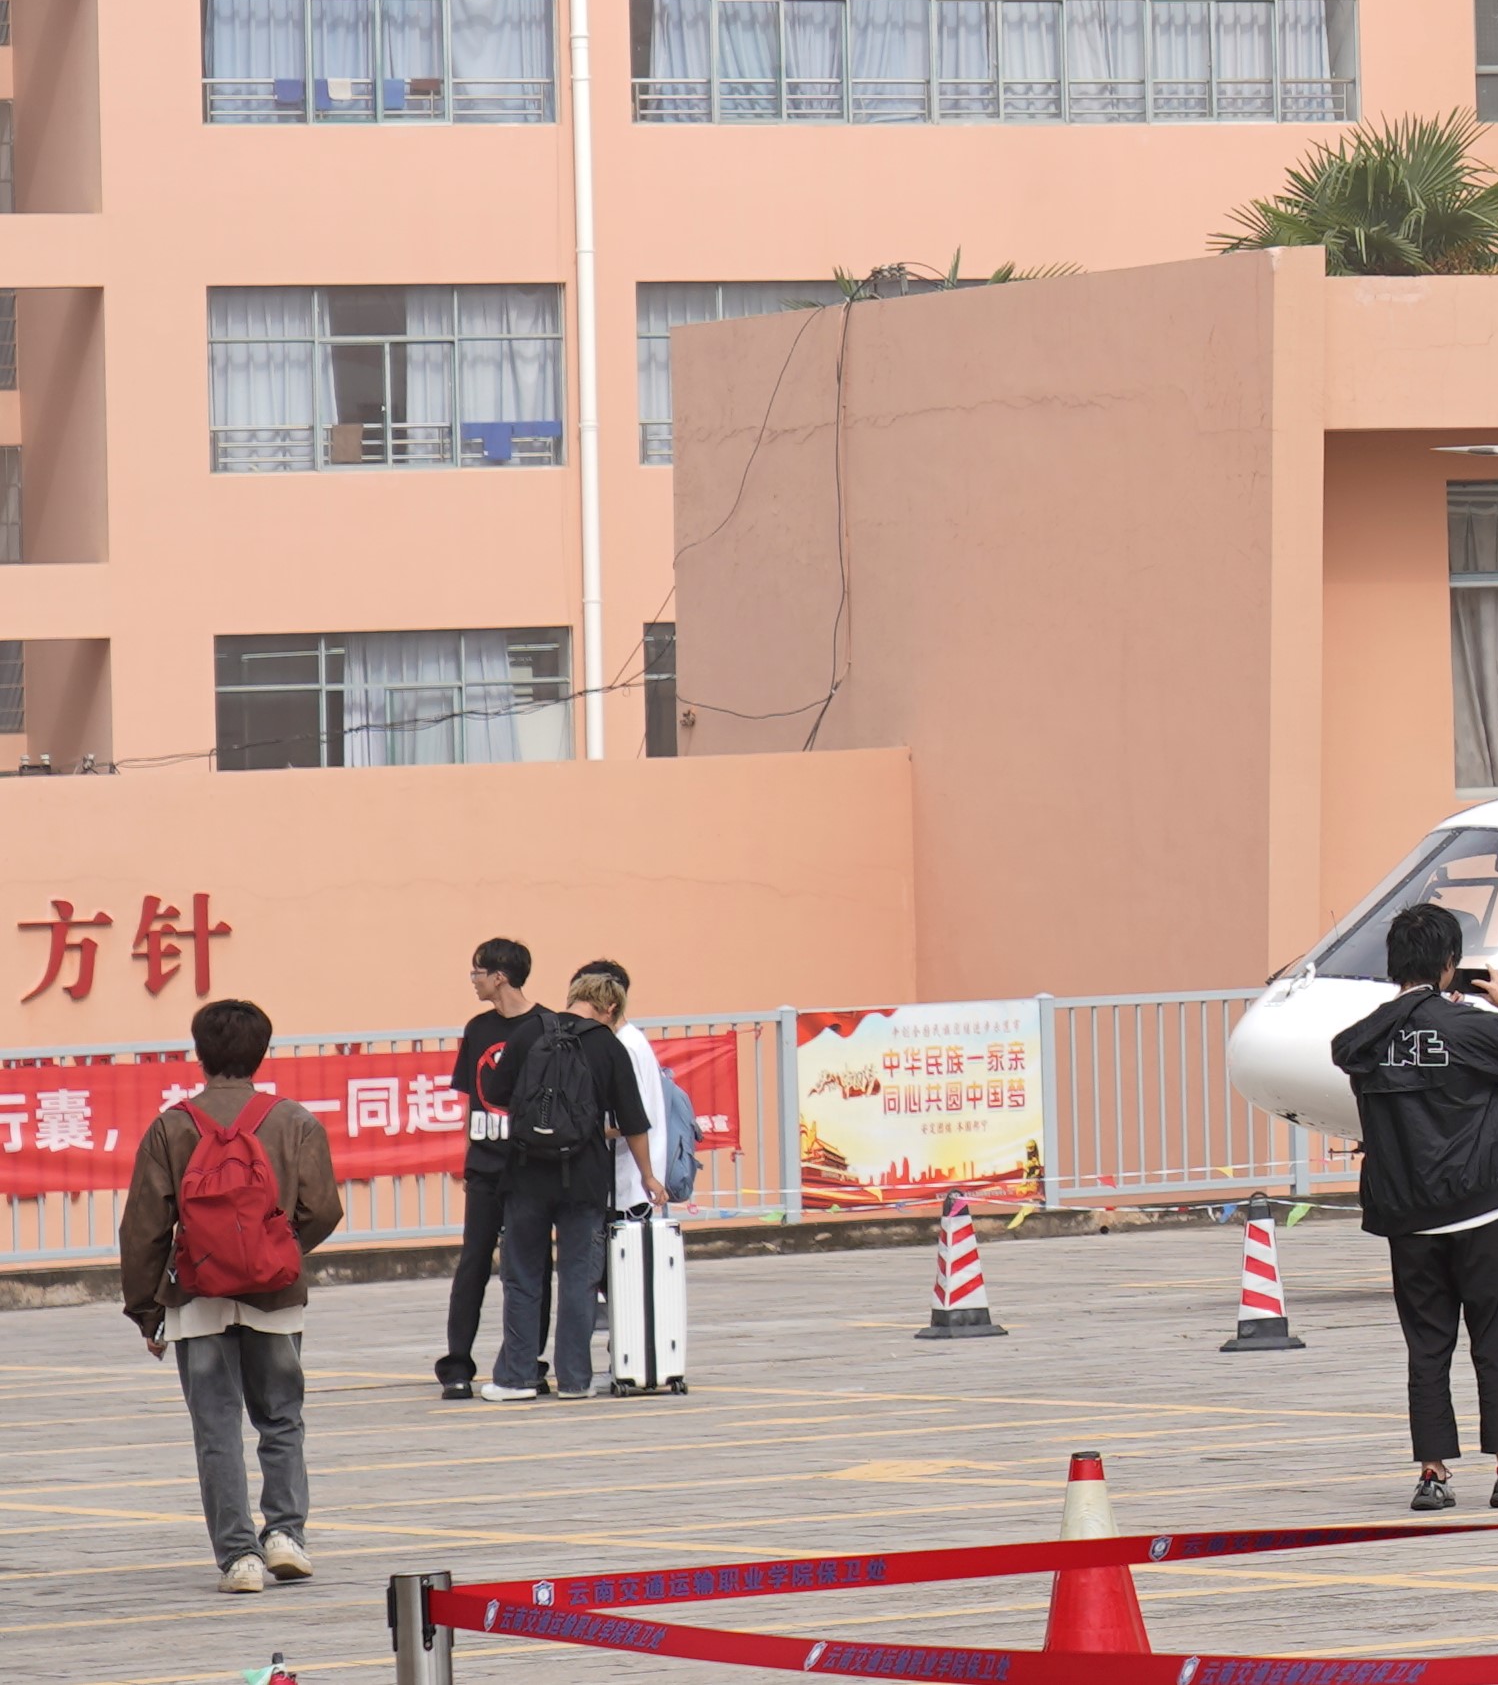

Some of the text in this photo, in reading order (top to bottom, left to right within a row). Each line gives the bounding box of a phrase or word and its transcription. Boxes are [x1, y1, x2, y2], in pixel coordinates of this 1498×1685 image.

[18, 893, 232, 1004] 方针
[883, 1041, 1026, 1077] 中华民族一家亲
[883, 1078, 1026, 1115] 同心共圆中国梦
[569, 1559, 887, 1606] 云南交通运输职业学院保卫处
[500, 1606, 667, 1650] 云南交通运输职业学院保卫处
[822, 1644, 1012, 1682] 云南交通运输职业学院保卫处
